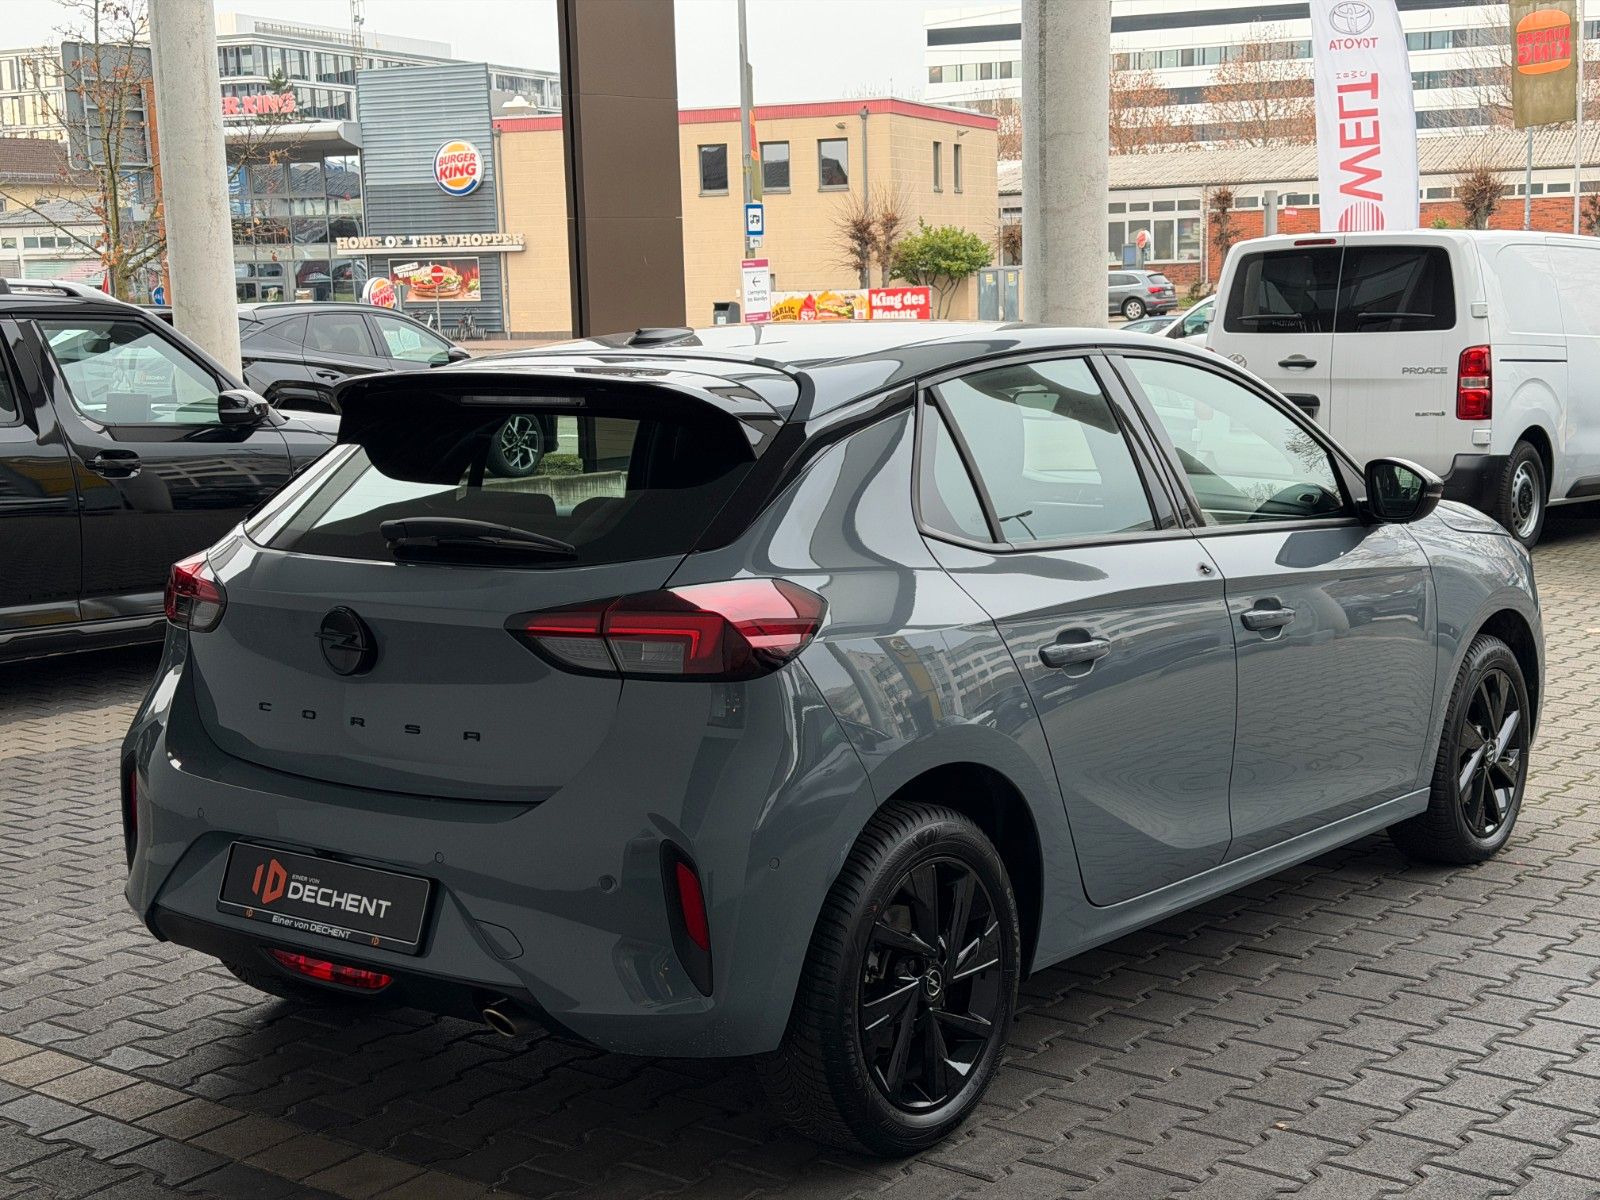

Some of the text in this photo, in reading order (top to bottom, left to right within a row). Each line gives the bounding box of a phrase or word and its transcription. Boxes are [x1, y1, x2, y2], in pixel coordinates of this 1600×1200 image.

[438, 152, 476, 167] BURGER
[439, 162, 477, 181] KING
[335, 232, 525, 249] HOME OF THE WHOPPER
[871, 291, 925, 309] King des
[771, 305, 795, 319] GARLIC
[1401, 366, 1448, 375] PROACE
[287, 881, 392, 919] DECHENT
[271, 914, 351, 939] Einer von DECHENT
